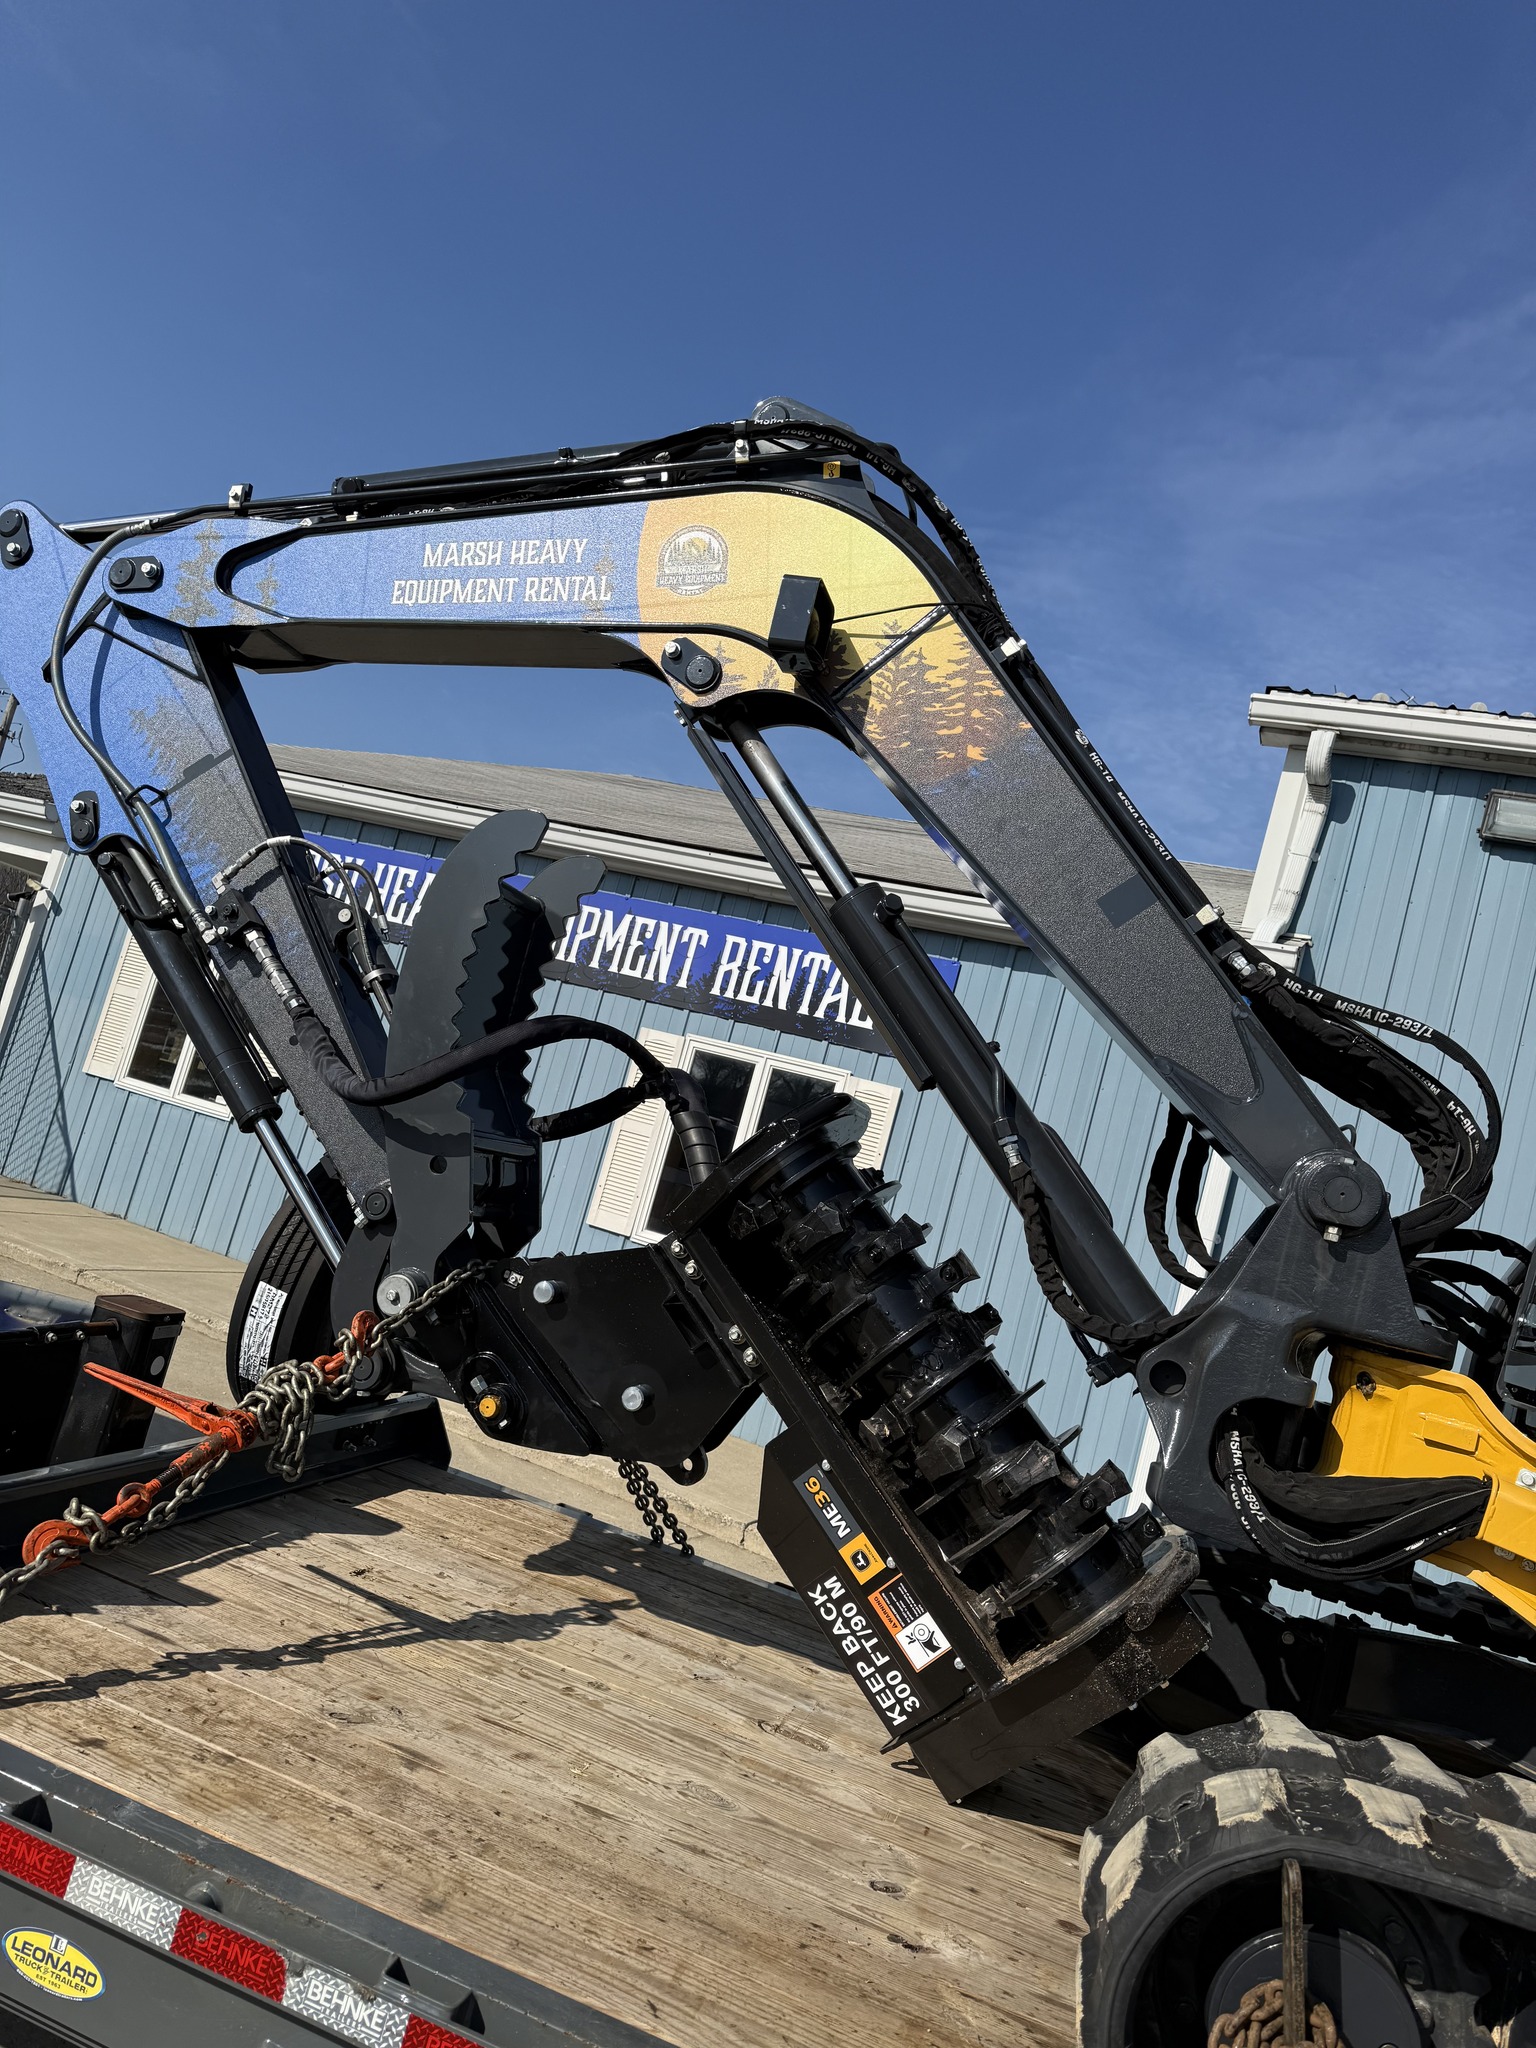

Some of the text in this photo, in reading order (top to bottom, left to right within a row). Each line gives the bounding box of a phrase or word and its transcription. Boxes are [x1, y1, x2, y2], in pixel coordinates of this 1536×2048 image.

[422, 538, 589, 568] MARSH HEAVY
[391, 575, 614, 606] EQUIPMENT RENTAL
[552, 904, 709, 988] IPMENT
[1283, 977, 1435, 1039] HG-14 MSHA IC-293/1
[1446, 1101, 1477, 1137] HG-14
[1229, 1430, 1243, 1472] MSHA
[804, 1476, 851, 1538] ME36
[807, 1583, 861, 1656] BACK
[874, 1596, 893, 1624] WARNING
[824, 1575, 920, 1713] 300 FT/90 M
[857, 1661, 908, 1726] KEEP
[0, 1835, 56, 1874] EHNKE
[88, 1876, 161, 1925] BEHNKE
[11, 1936, 97, 1988] LEONARD
[14, 1953, 43, 1973] TRUCK
[50, 1970, 86, 1994] TRAILER
[36, 1974, 47, 1982] EST
[48, 1980, 61, 1989] 1963
[307, 1979, 388, 2032] BEHNKE
